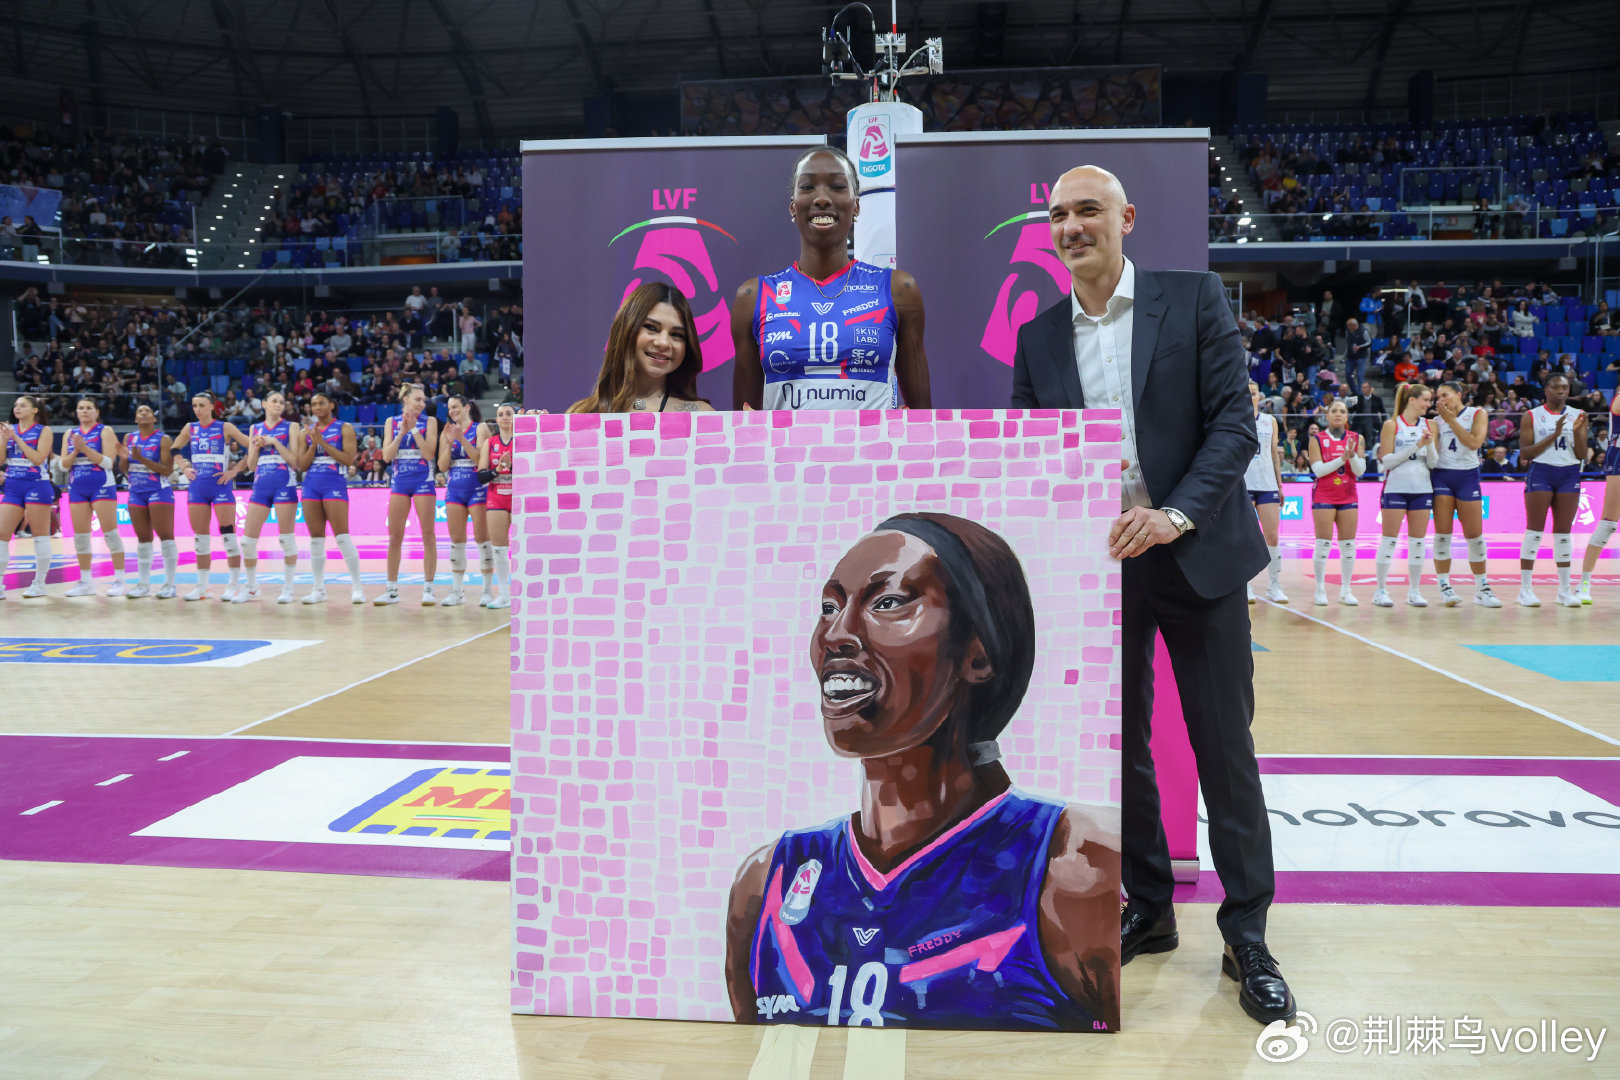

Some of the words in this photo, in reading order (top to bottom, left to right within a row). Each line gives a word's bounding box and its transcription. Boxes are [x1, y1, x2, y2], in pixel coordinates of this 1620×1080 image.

[652, 187, 697, 210] LVF
[765, 330, 793, 345] SYM
[855, 328, 878, 336] SKIN
[808, 321, 839, 363] 18
[806, 384, 866, 402] numia
[199, 437, 210, 451] 25
[1448, 438, 1458, 453] 4
[1554, 436, 1568, 451] 14
[907, 929, 962, 957] FREDDY
[827, 961, 888, 1027] 18
[756, 994, 800, 1020] SYM
[1093, 1020, 1108, 1030] ELA
